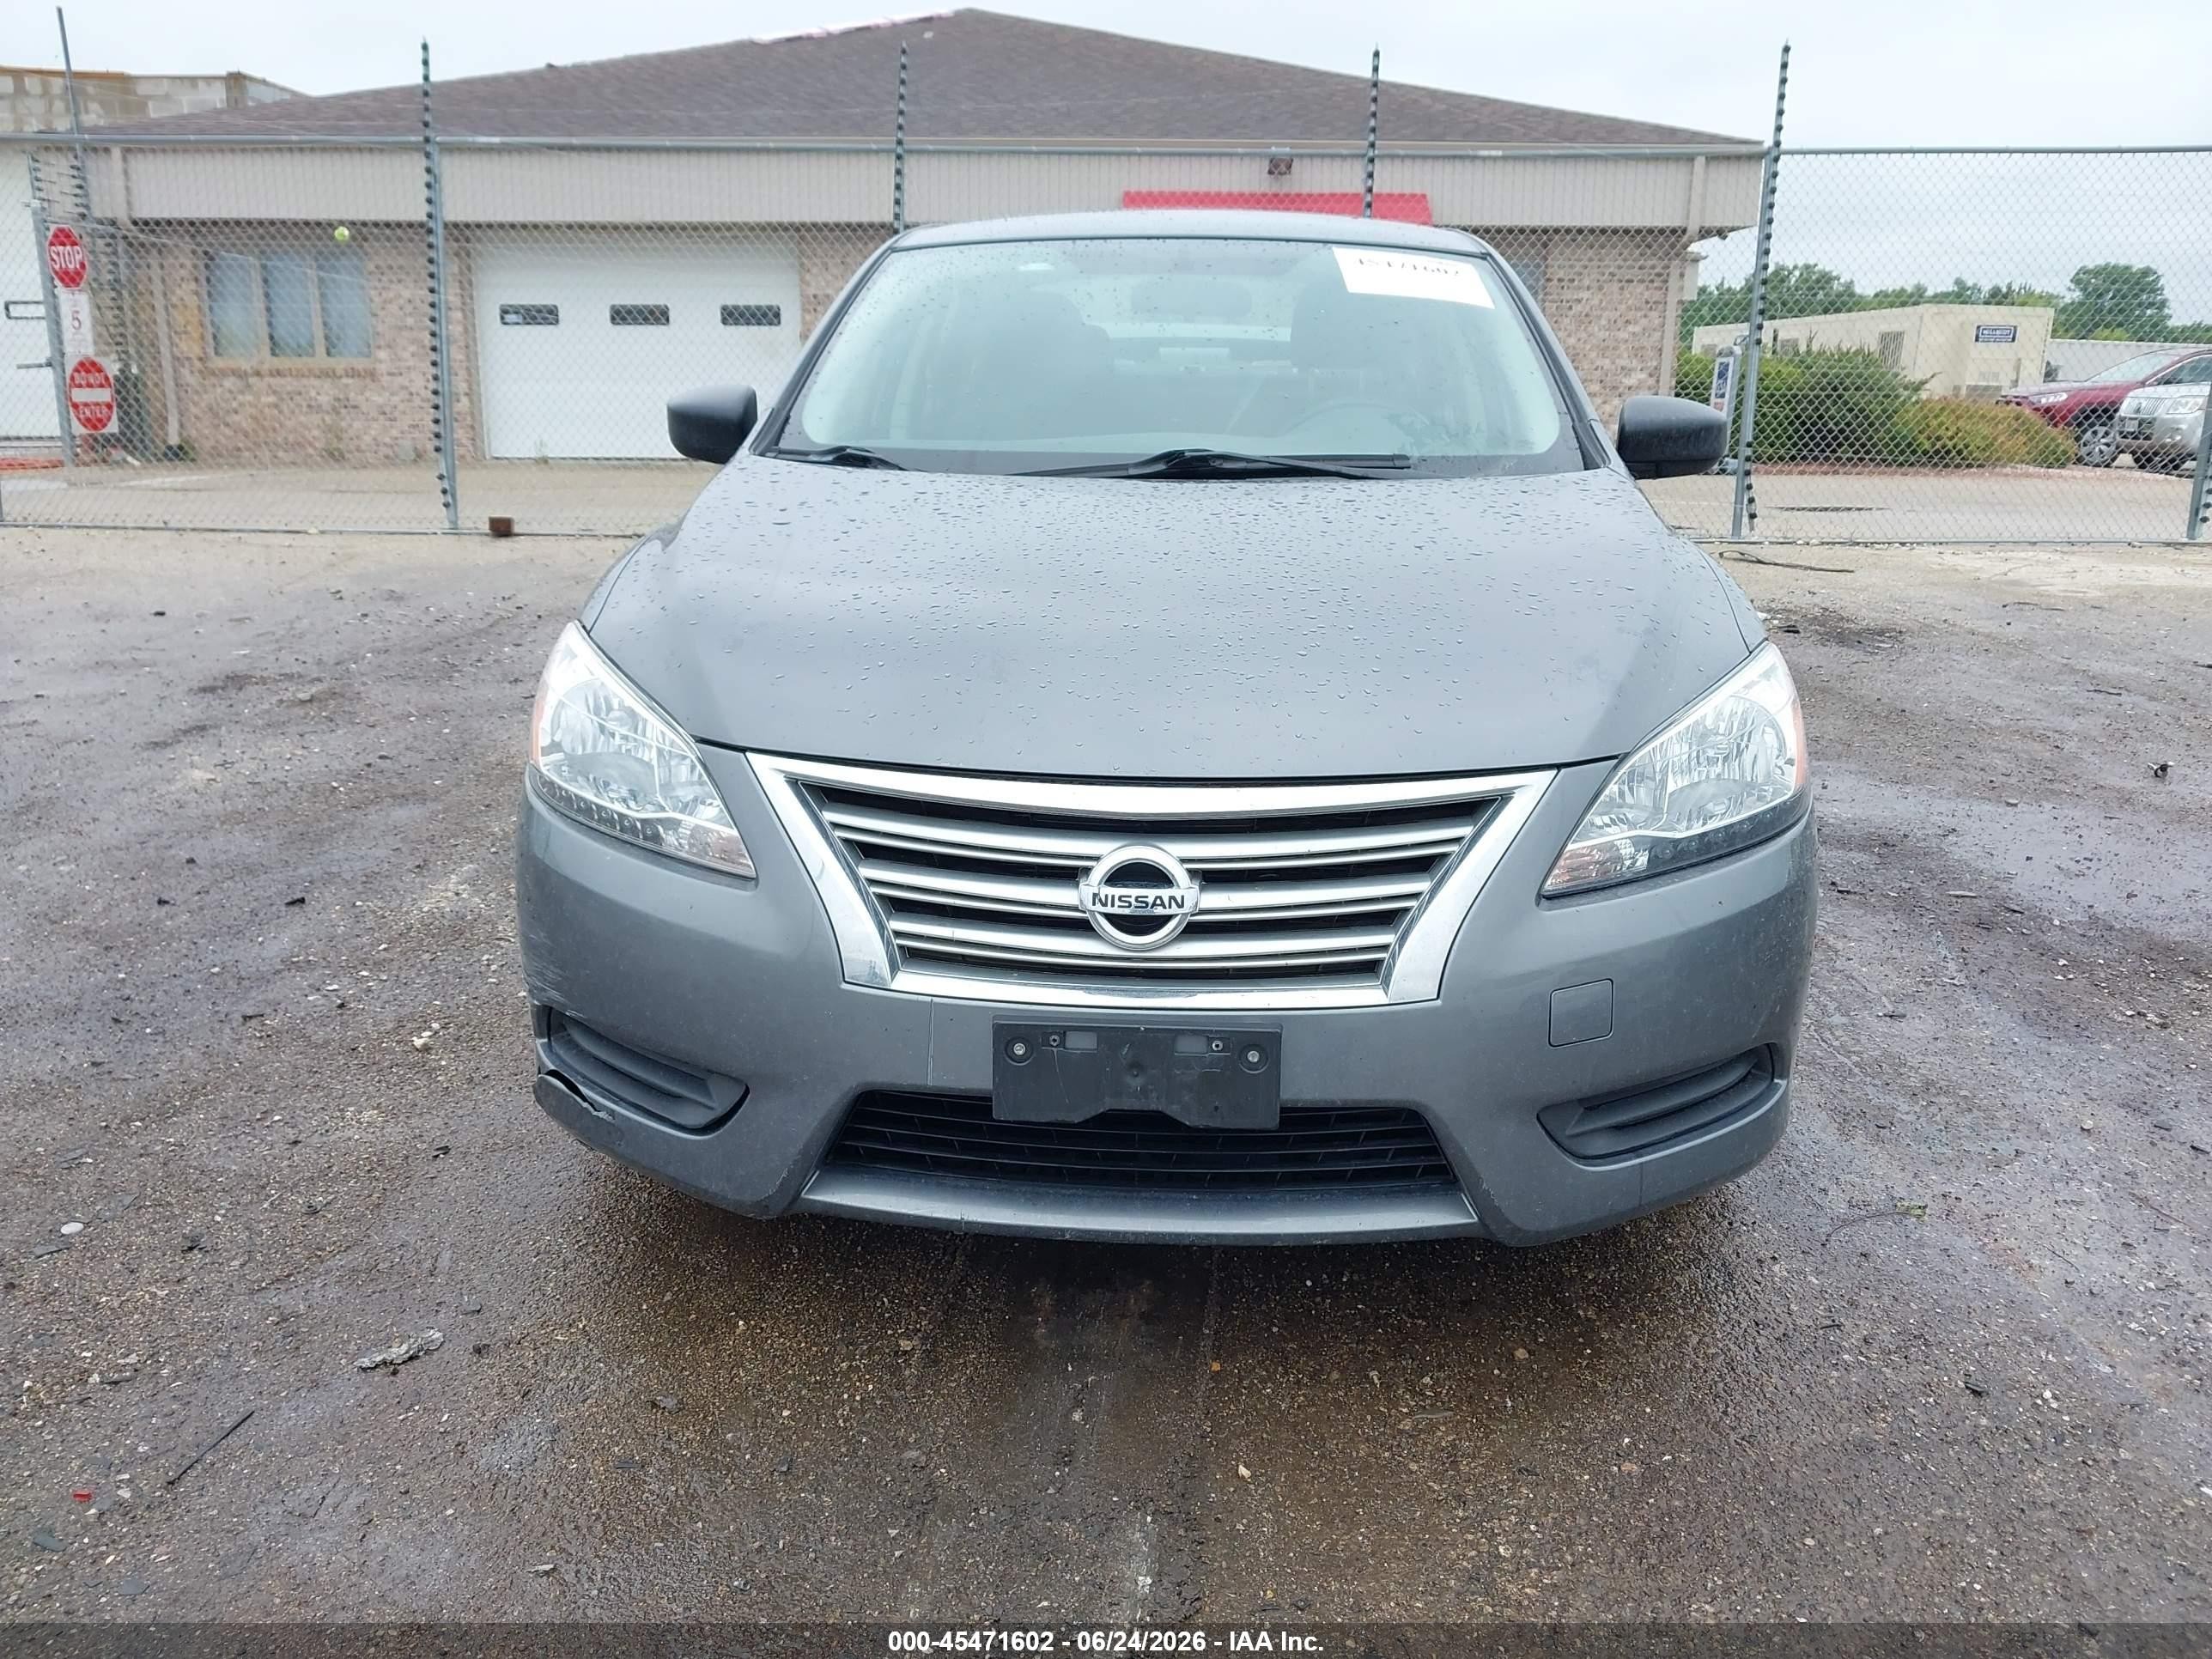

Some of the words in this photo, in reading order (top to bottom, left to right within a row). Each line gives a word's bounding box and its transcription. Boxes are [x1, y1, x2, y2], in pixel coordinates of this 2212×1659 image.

[50, 246, 82, 269] STOP
[71, 310, 82, 330] 5
[1091, 892, 1185, 909] NISSAN
